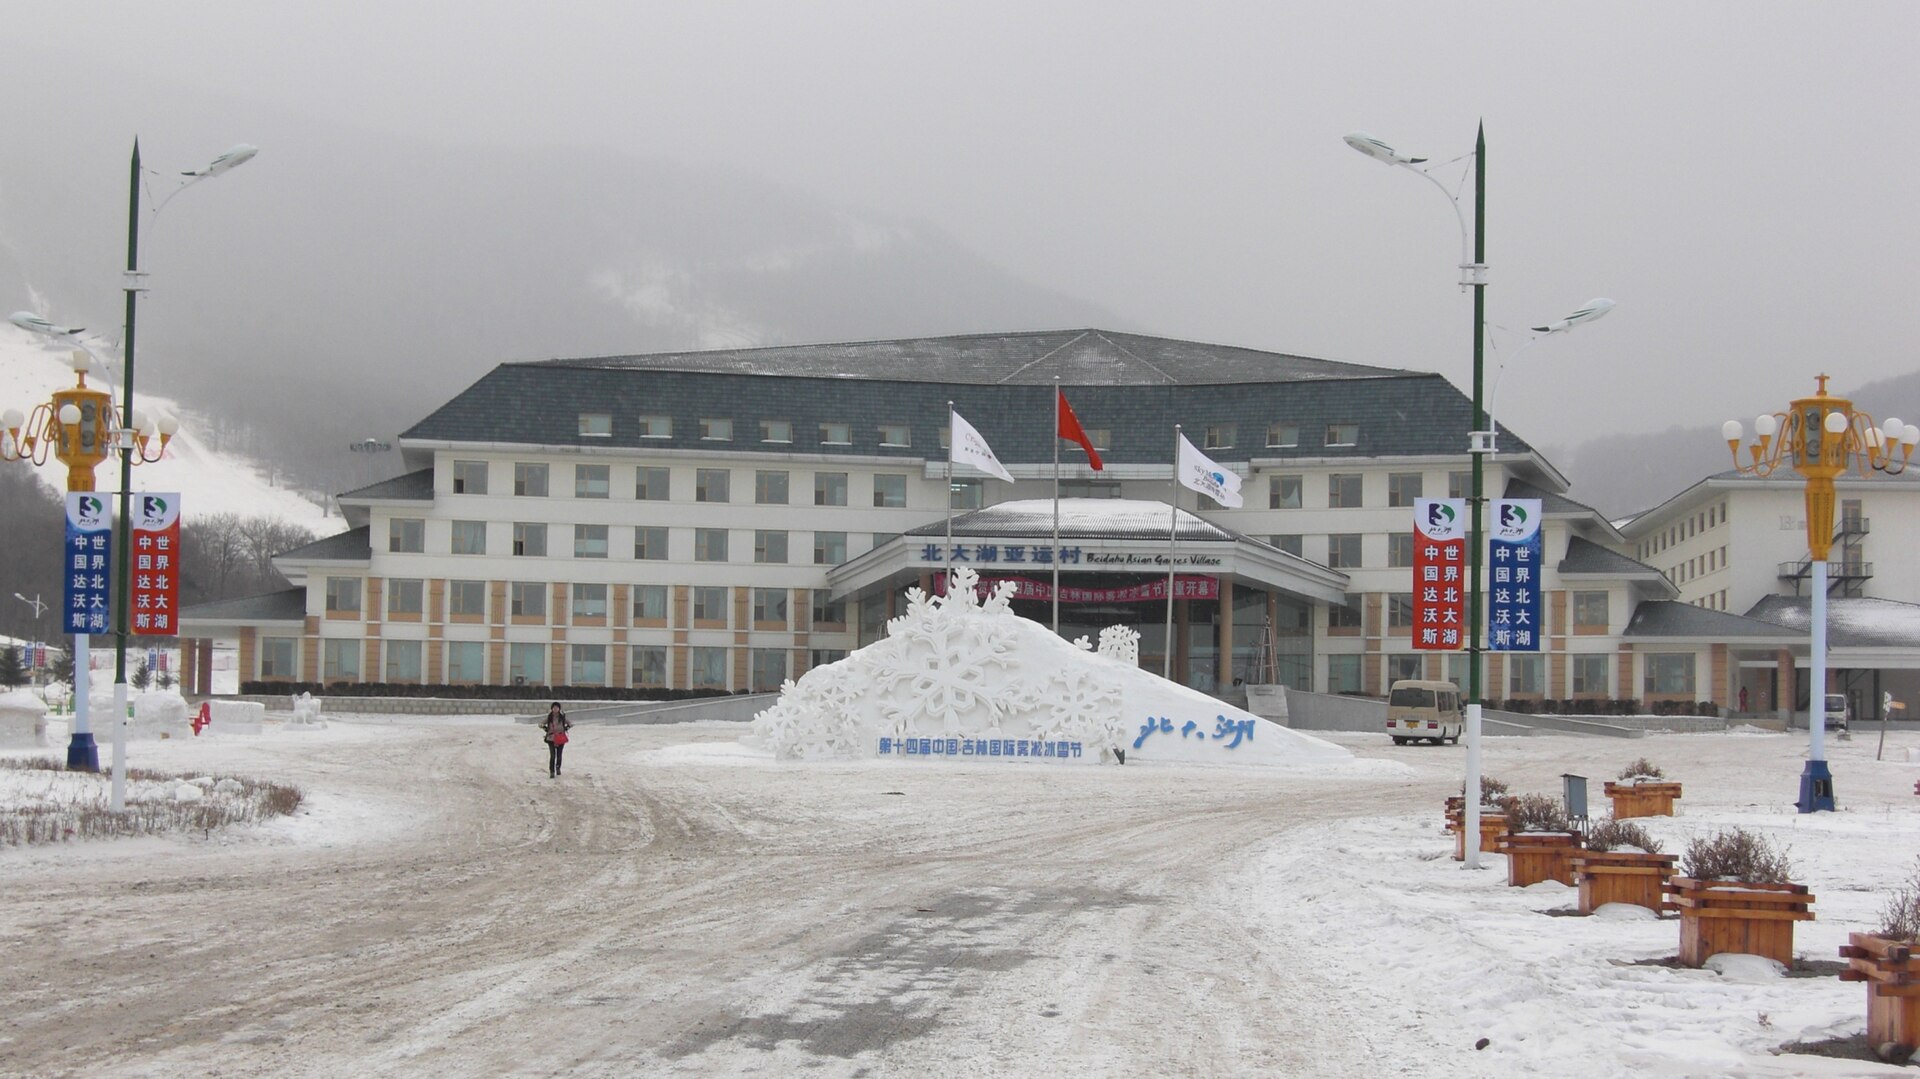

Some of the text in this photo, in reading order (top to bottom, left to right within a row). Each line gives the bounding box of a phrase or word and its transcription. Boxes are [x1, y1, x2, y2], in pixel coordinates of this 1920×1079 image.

[72, 535, 87, 628] 中国达沃斯
[90, 535, 105, 628] 世界北大湖
[136, 535, 152, 628] 中国达沃斯
[154, 535, 170, 628] 世界北大湖
[921, 543, 1082, 564] 北大湖亚运村
[1087, 553, 1124, 563] Beidahu
[1126, 554, 1152, 564] Asian
[1190, 554, 1222, 565] Village
[1422, 545, 1439, 644] 中国达沃斯
[1442, 546, 1459, 645] 世界北大湖
[1495, 546, 1511, 646] 中国达沃斯
[1515, 547, 1531, 646] 世界北大湖
[1132, 715, 1256, 749] 北大湖
